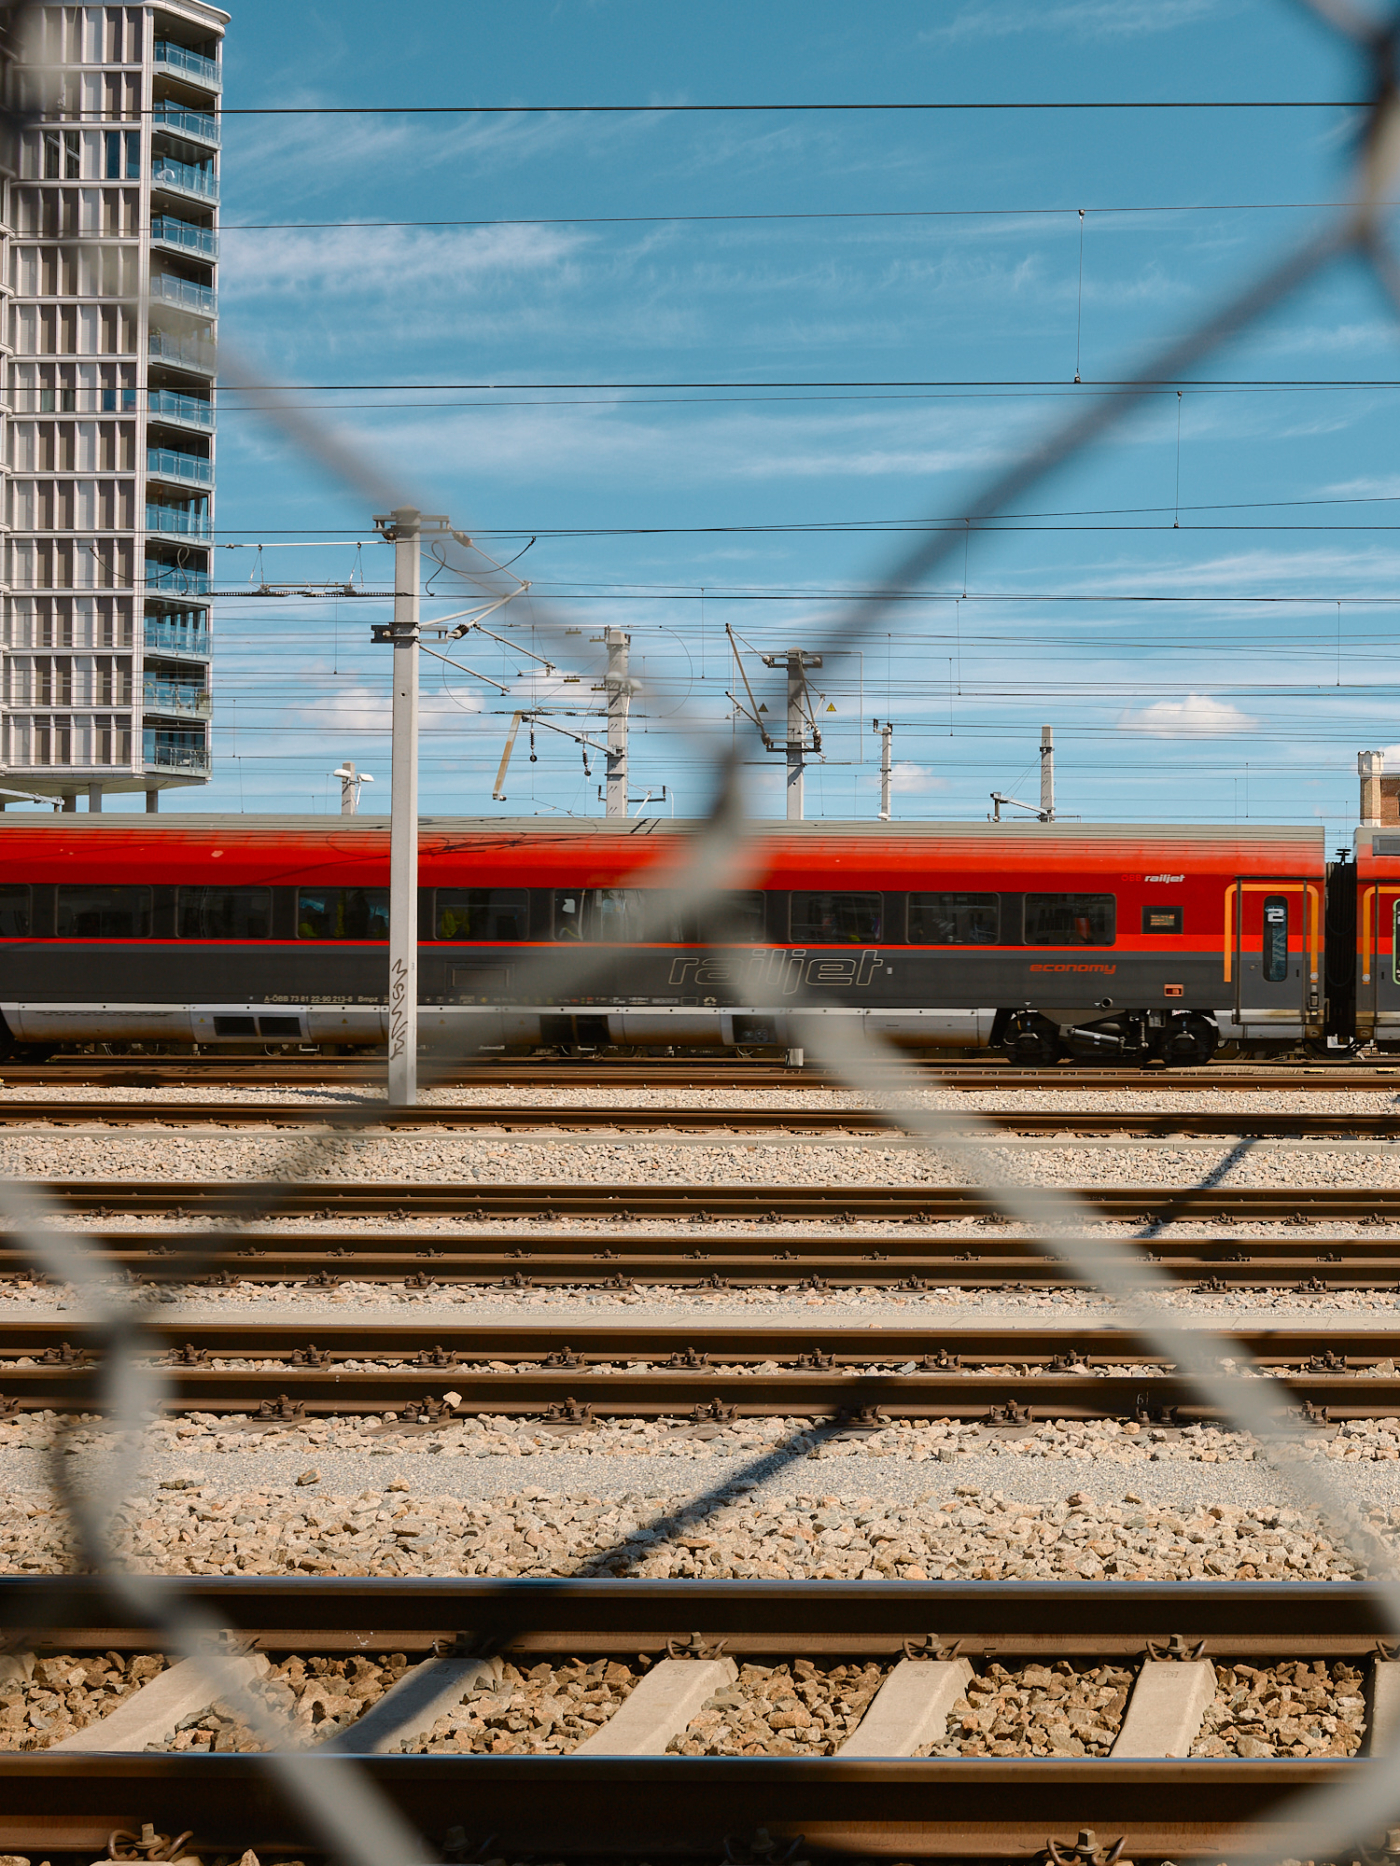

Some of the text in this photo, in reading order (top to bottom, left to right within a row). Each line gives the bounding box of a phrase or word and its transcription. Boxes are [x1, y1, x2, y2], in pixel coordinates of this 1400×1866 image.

[1144, 874, 1186, 884] railjet
[1267, 908, 1285, 923] 2
[668, 949, 884, 995] railjet
[1029, 964, 1117, 975] economy
